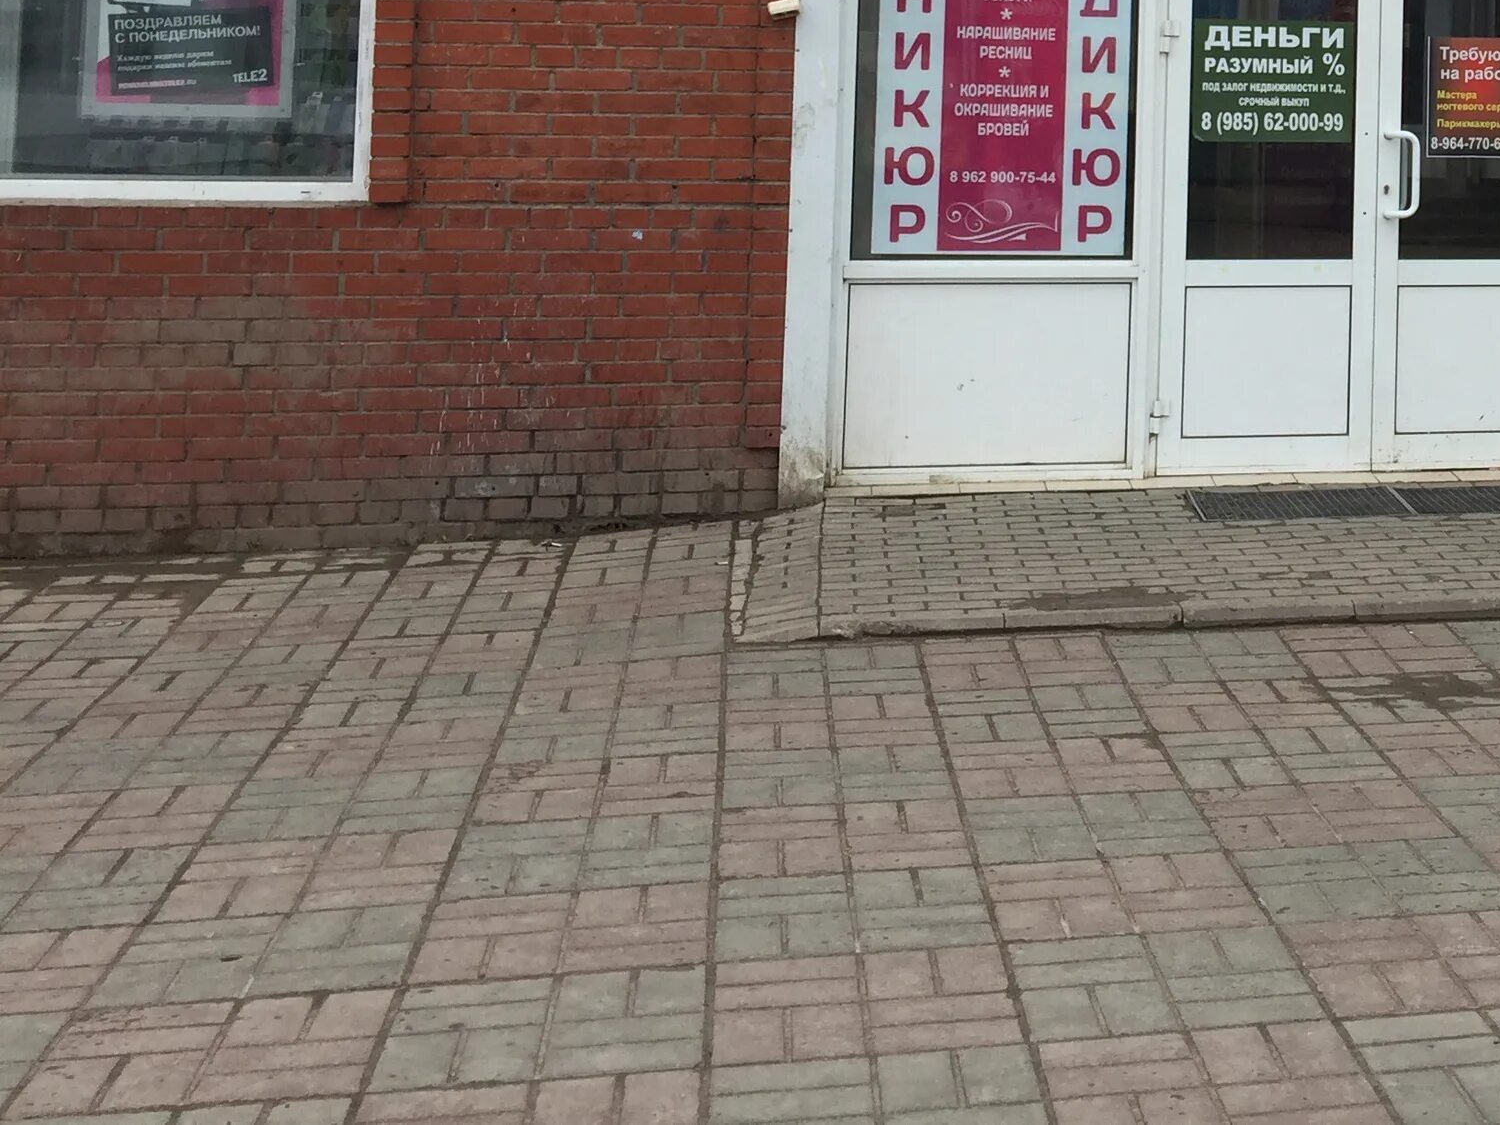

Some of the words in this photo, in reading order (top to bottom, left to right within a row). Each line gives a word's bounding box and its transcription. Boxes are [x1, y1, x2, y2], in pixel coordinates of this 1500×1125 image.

[114, 14, 222, 31] ПОЗДРАВЛЯЕМ
[115, 33, 126, 44] С
[129, 25, 261, 44] ПОНЕДЕЛЬНИКОМ!
[1204, 25, 1345, 51] ДЕНЬГИ
[979, 45, 1033, 60] РЕСНИЦ
[1204, 55, 1314, 74] РАЗУМНЫЙ
[1322, 52, 1346, 76] %
[232, 68, 268, 84] TELE2
[1440, 69, 1459, 80] на
[959, 83, 1037, 98] КОРРЕКЦИЯ
[1040, 85, 1049, 98] И
[1202, 82, 1220, 92] ПОД
[1222, 82, 1248, 92] ЗАЛОГ
[1250, 82, 1318, 93] НЕДВИЖИМОСТИ
[1238, 95, 1279, 106] СРОЧНЫЙ
[1436, 90, 1477, 101] Мастера
[954, 102, 1053, 117] ОКРАШИВАНИЕ
[1436, 103, 1484, 112] ногтевого
[977, 120, 1030, 136] БРОВЕЙ
[1201, 111, 1212, 131] 8
[1216, 111, 1259, 135] (985)
[1263, 112, 1344, 131] 62-000-99
[950, 171, 958, 183] 8
[962, 171, 986, 183] 962
[990, 171, 1056, 184] 900-75-44
